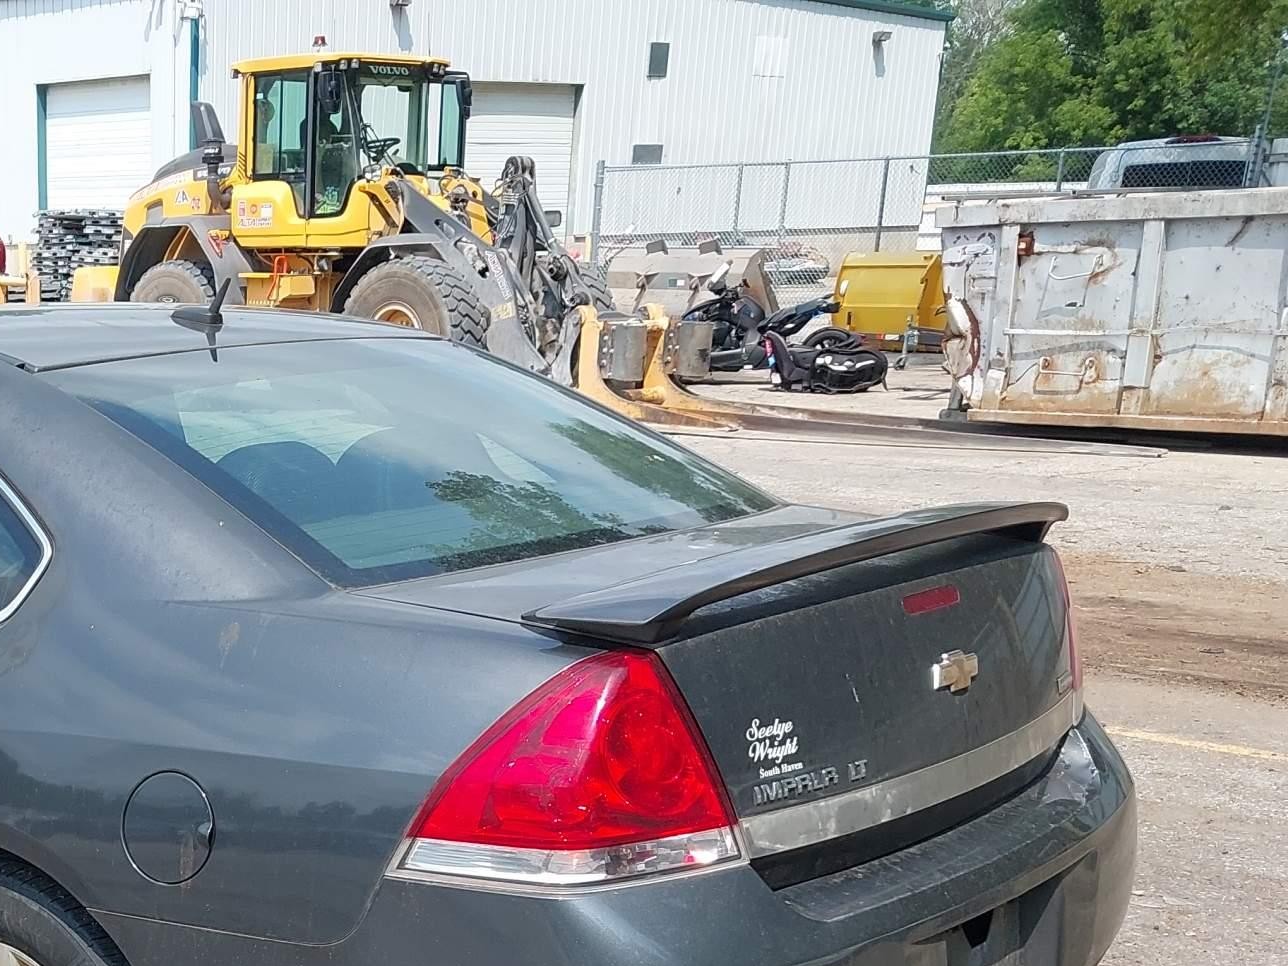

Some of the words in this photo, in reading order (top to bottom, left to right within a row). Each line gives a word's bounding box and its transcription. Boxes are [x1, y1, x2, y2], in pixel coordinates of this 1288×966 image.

[368, 65, 409, 76] VOLVO
[746, 718, 793, 741] Seelye
[748, 736, 798, 764] Wright
[759, 766, 781, 779] South
[781, 762, 803, 774] Haven
[753, 766, 839, 807] IMPALA
[847, 759, 868, 783] LT
